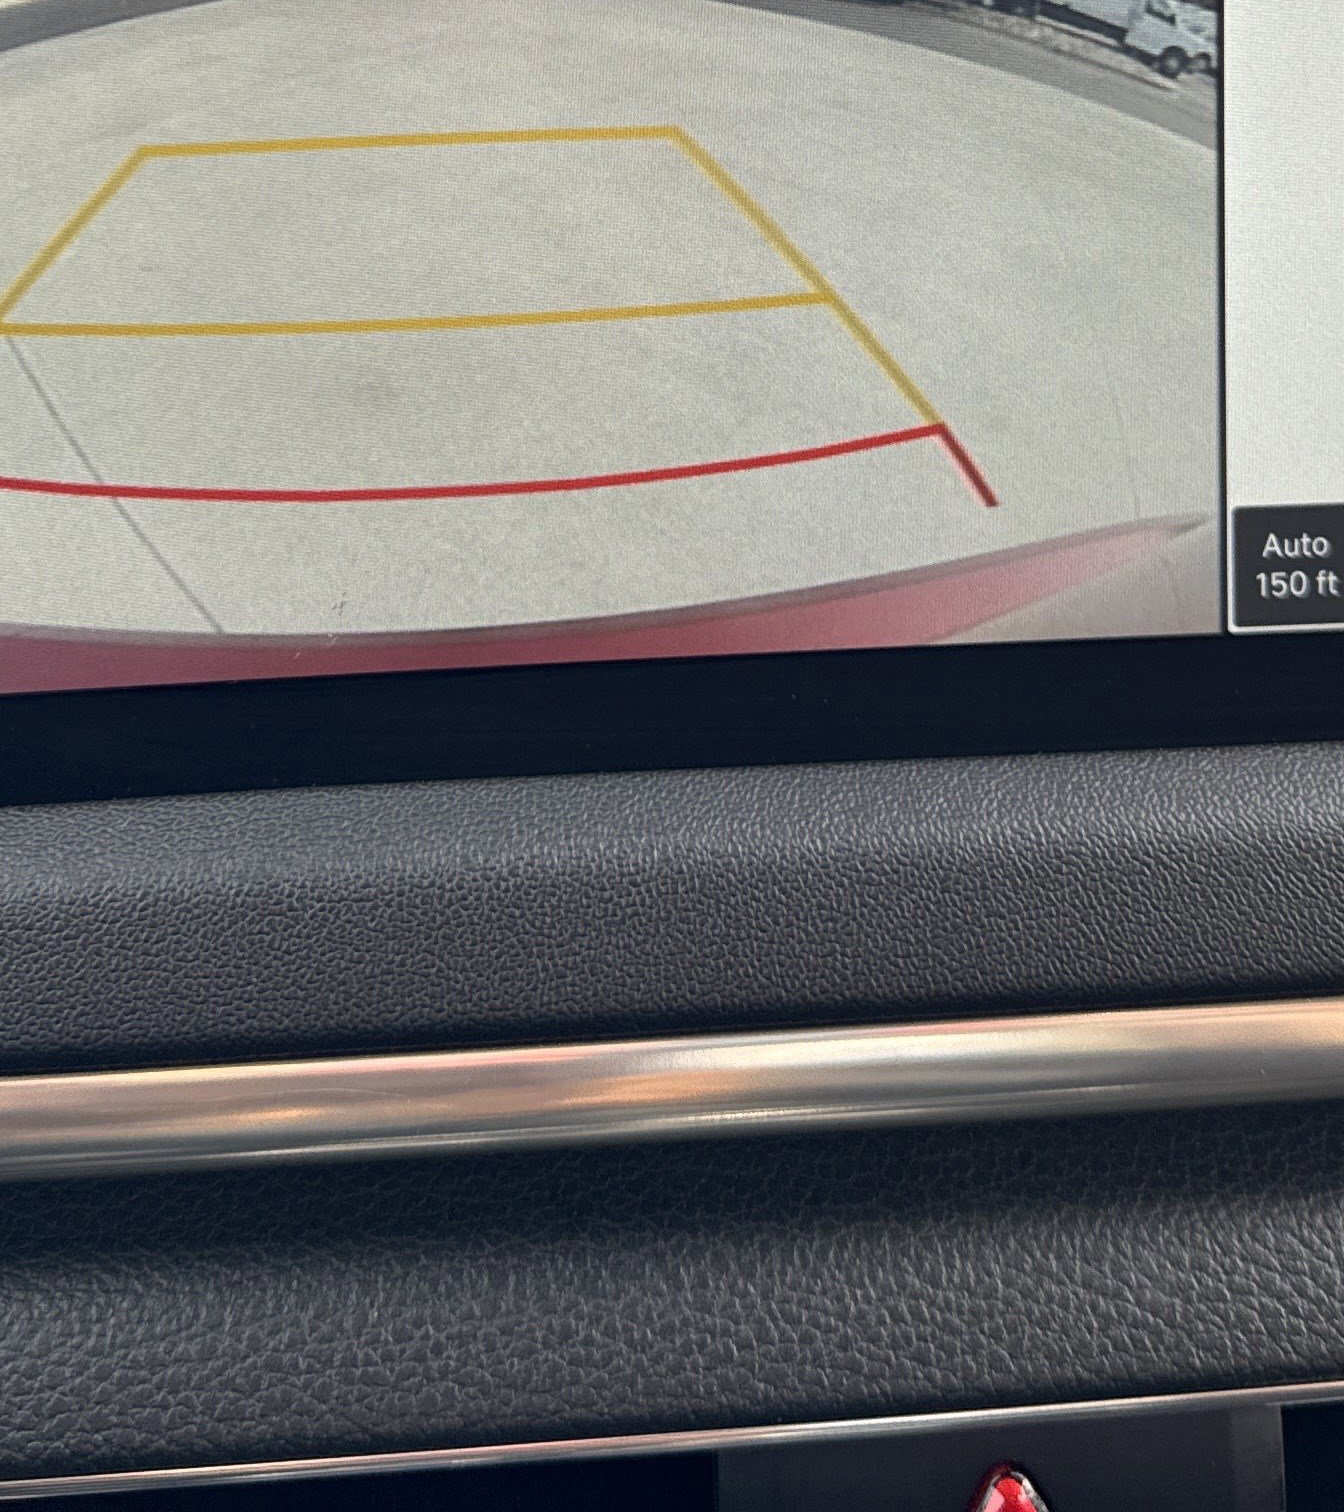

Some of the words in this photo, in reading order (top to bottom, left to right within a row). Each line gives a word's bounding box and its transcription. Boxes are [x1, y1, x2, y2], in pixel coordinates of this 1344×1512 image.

[1262, 533, 1331, 559] Auto
[1256, 570, 1309, 599] 150
[1316, 569, 1341, 596] ft
